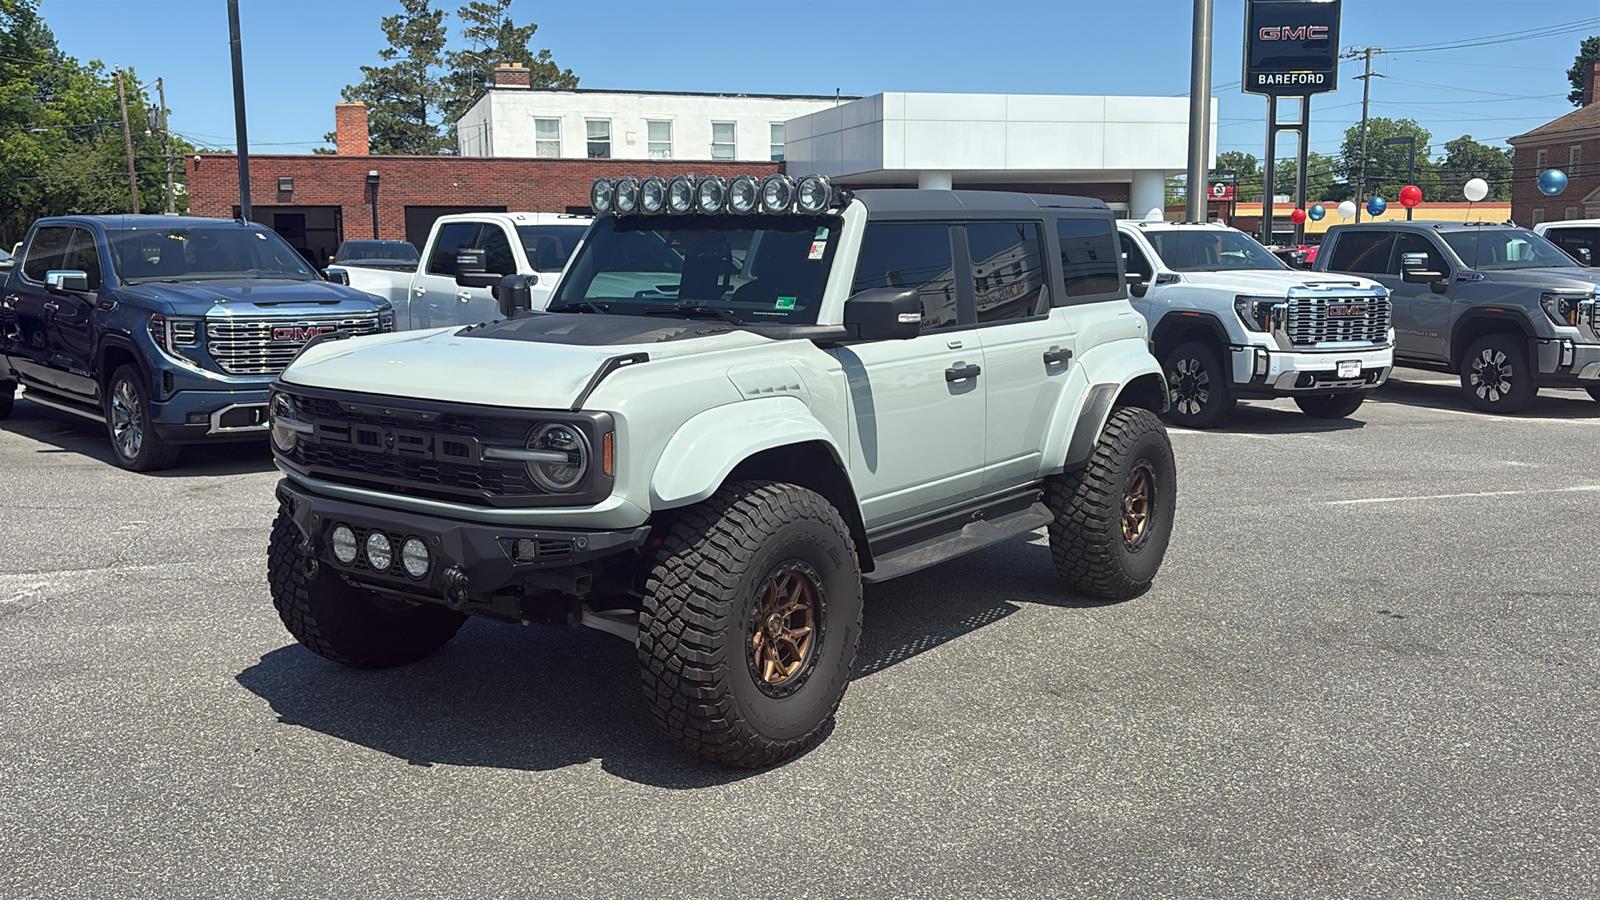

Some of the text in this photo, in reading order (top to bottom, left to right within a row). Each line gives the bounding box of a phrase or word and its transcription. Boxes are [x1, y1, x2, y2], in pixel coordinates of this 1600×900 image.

[1259, 25, 1329, 41] GMC
[1258, 73, 1325, 85] BAREFORD
[1329, 304, 1367, 317] GMC
[273, 326, 335, 340] GMC
[313, 416, 481, 465] FORD
